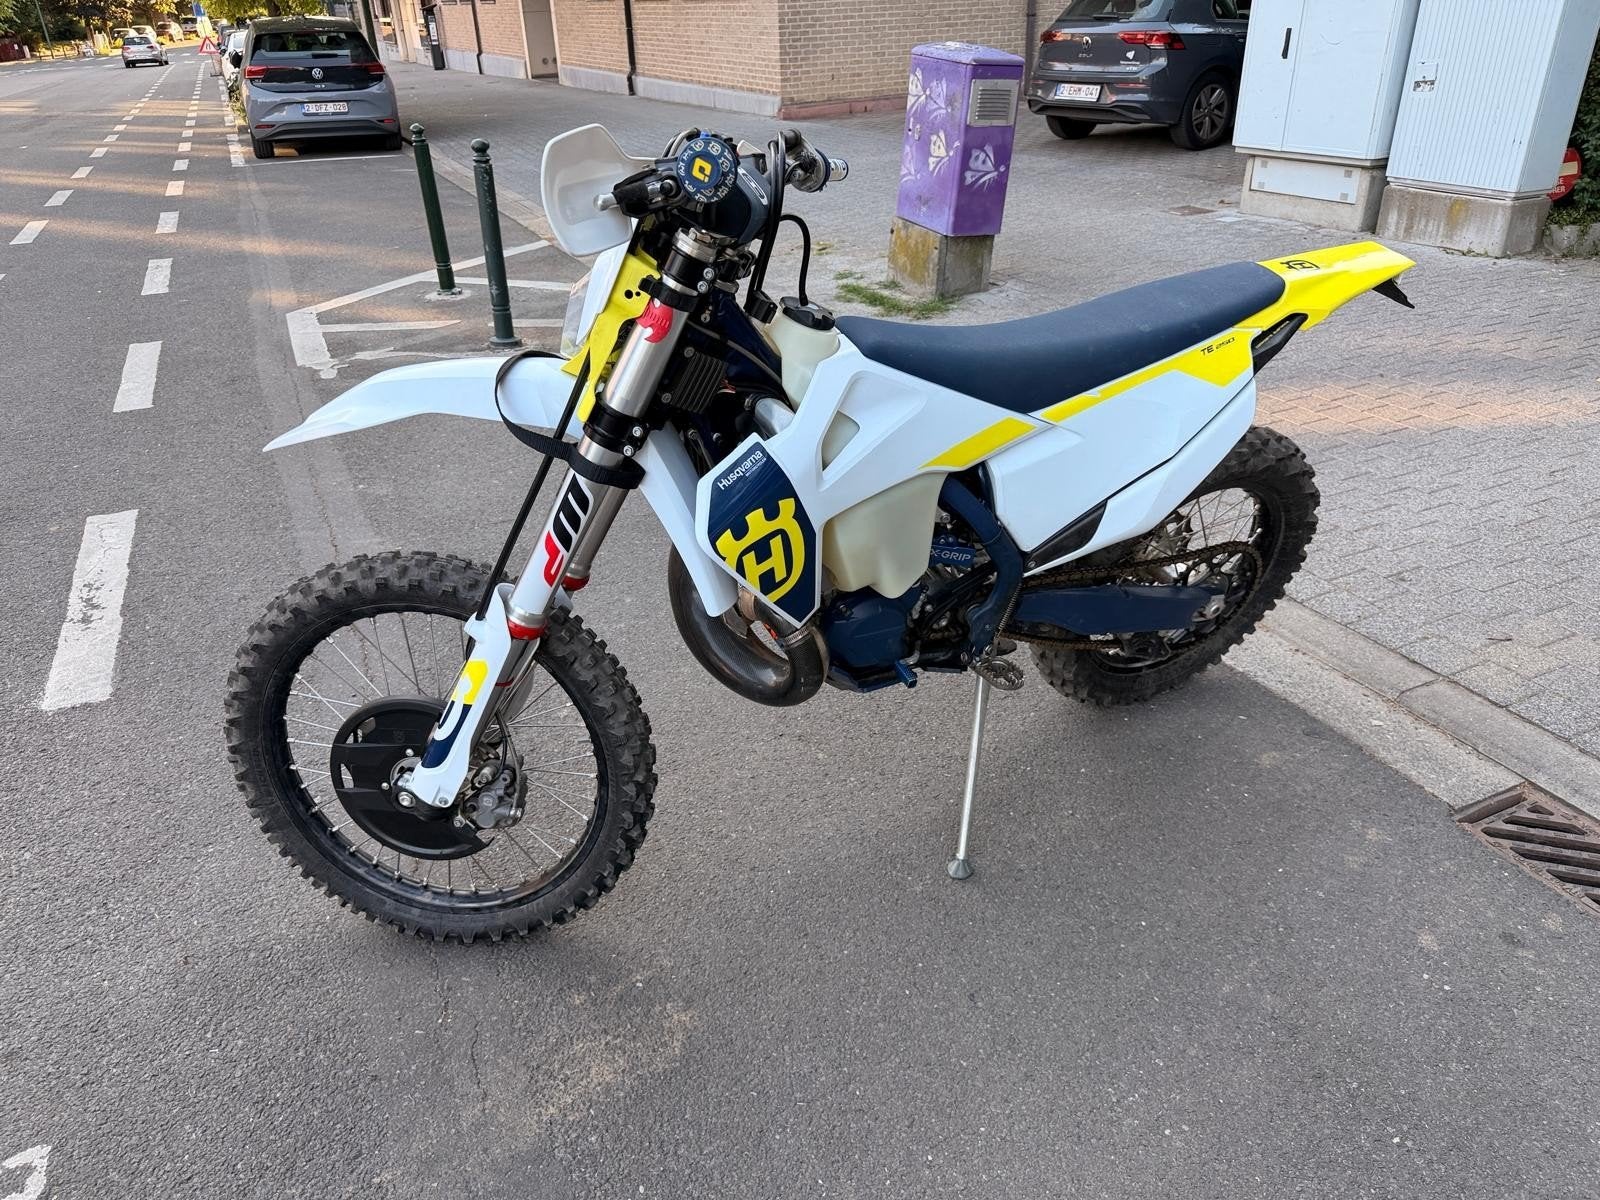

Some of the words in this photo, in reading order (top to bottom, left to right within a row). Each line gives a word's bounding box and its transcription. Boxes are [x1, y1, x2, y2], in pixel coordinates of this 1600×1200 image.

[1200, 344, 1214, 356] TE
[1216, 337, 1236, 350] 250
[717, 450, 763, 490] Husqvarna
